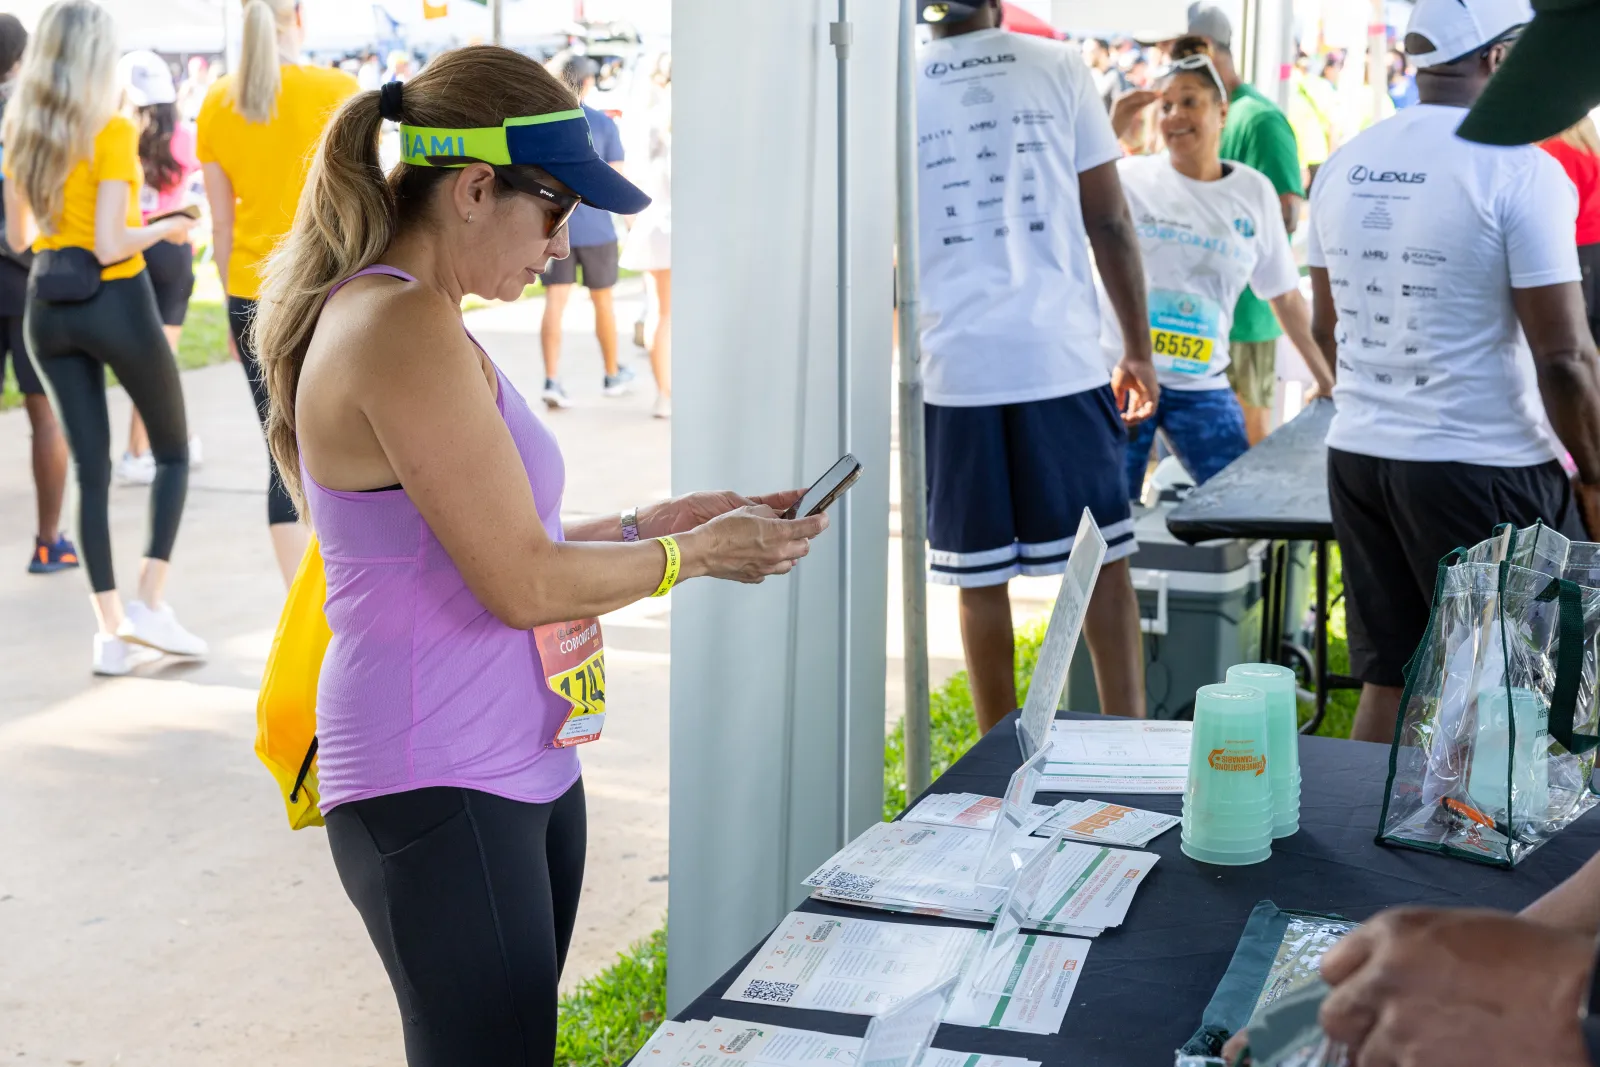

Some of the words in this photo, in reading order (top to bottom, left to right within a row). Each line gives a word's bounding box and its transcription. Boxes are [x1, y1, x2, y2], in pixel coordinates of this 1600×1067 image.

[949, 53, 1017, 71] LEXUS
[400, 132, 465, 158] IAMI
[1368, 170, 1427, 184] LEXUS
[1154, 332, 1204, 360] 6552
[1214, 761, 1262, 772] CONVERSATIONS
[1221, 755, 1253, 763] CANNABIS
